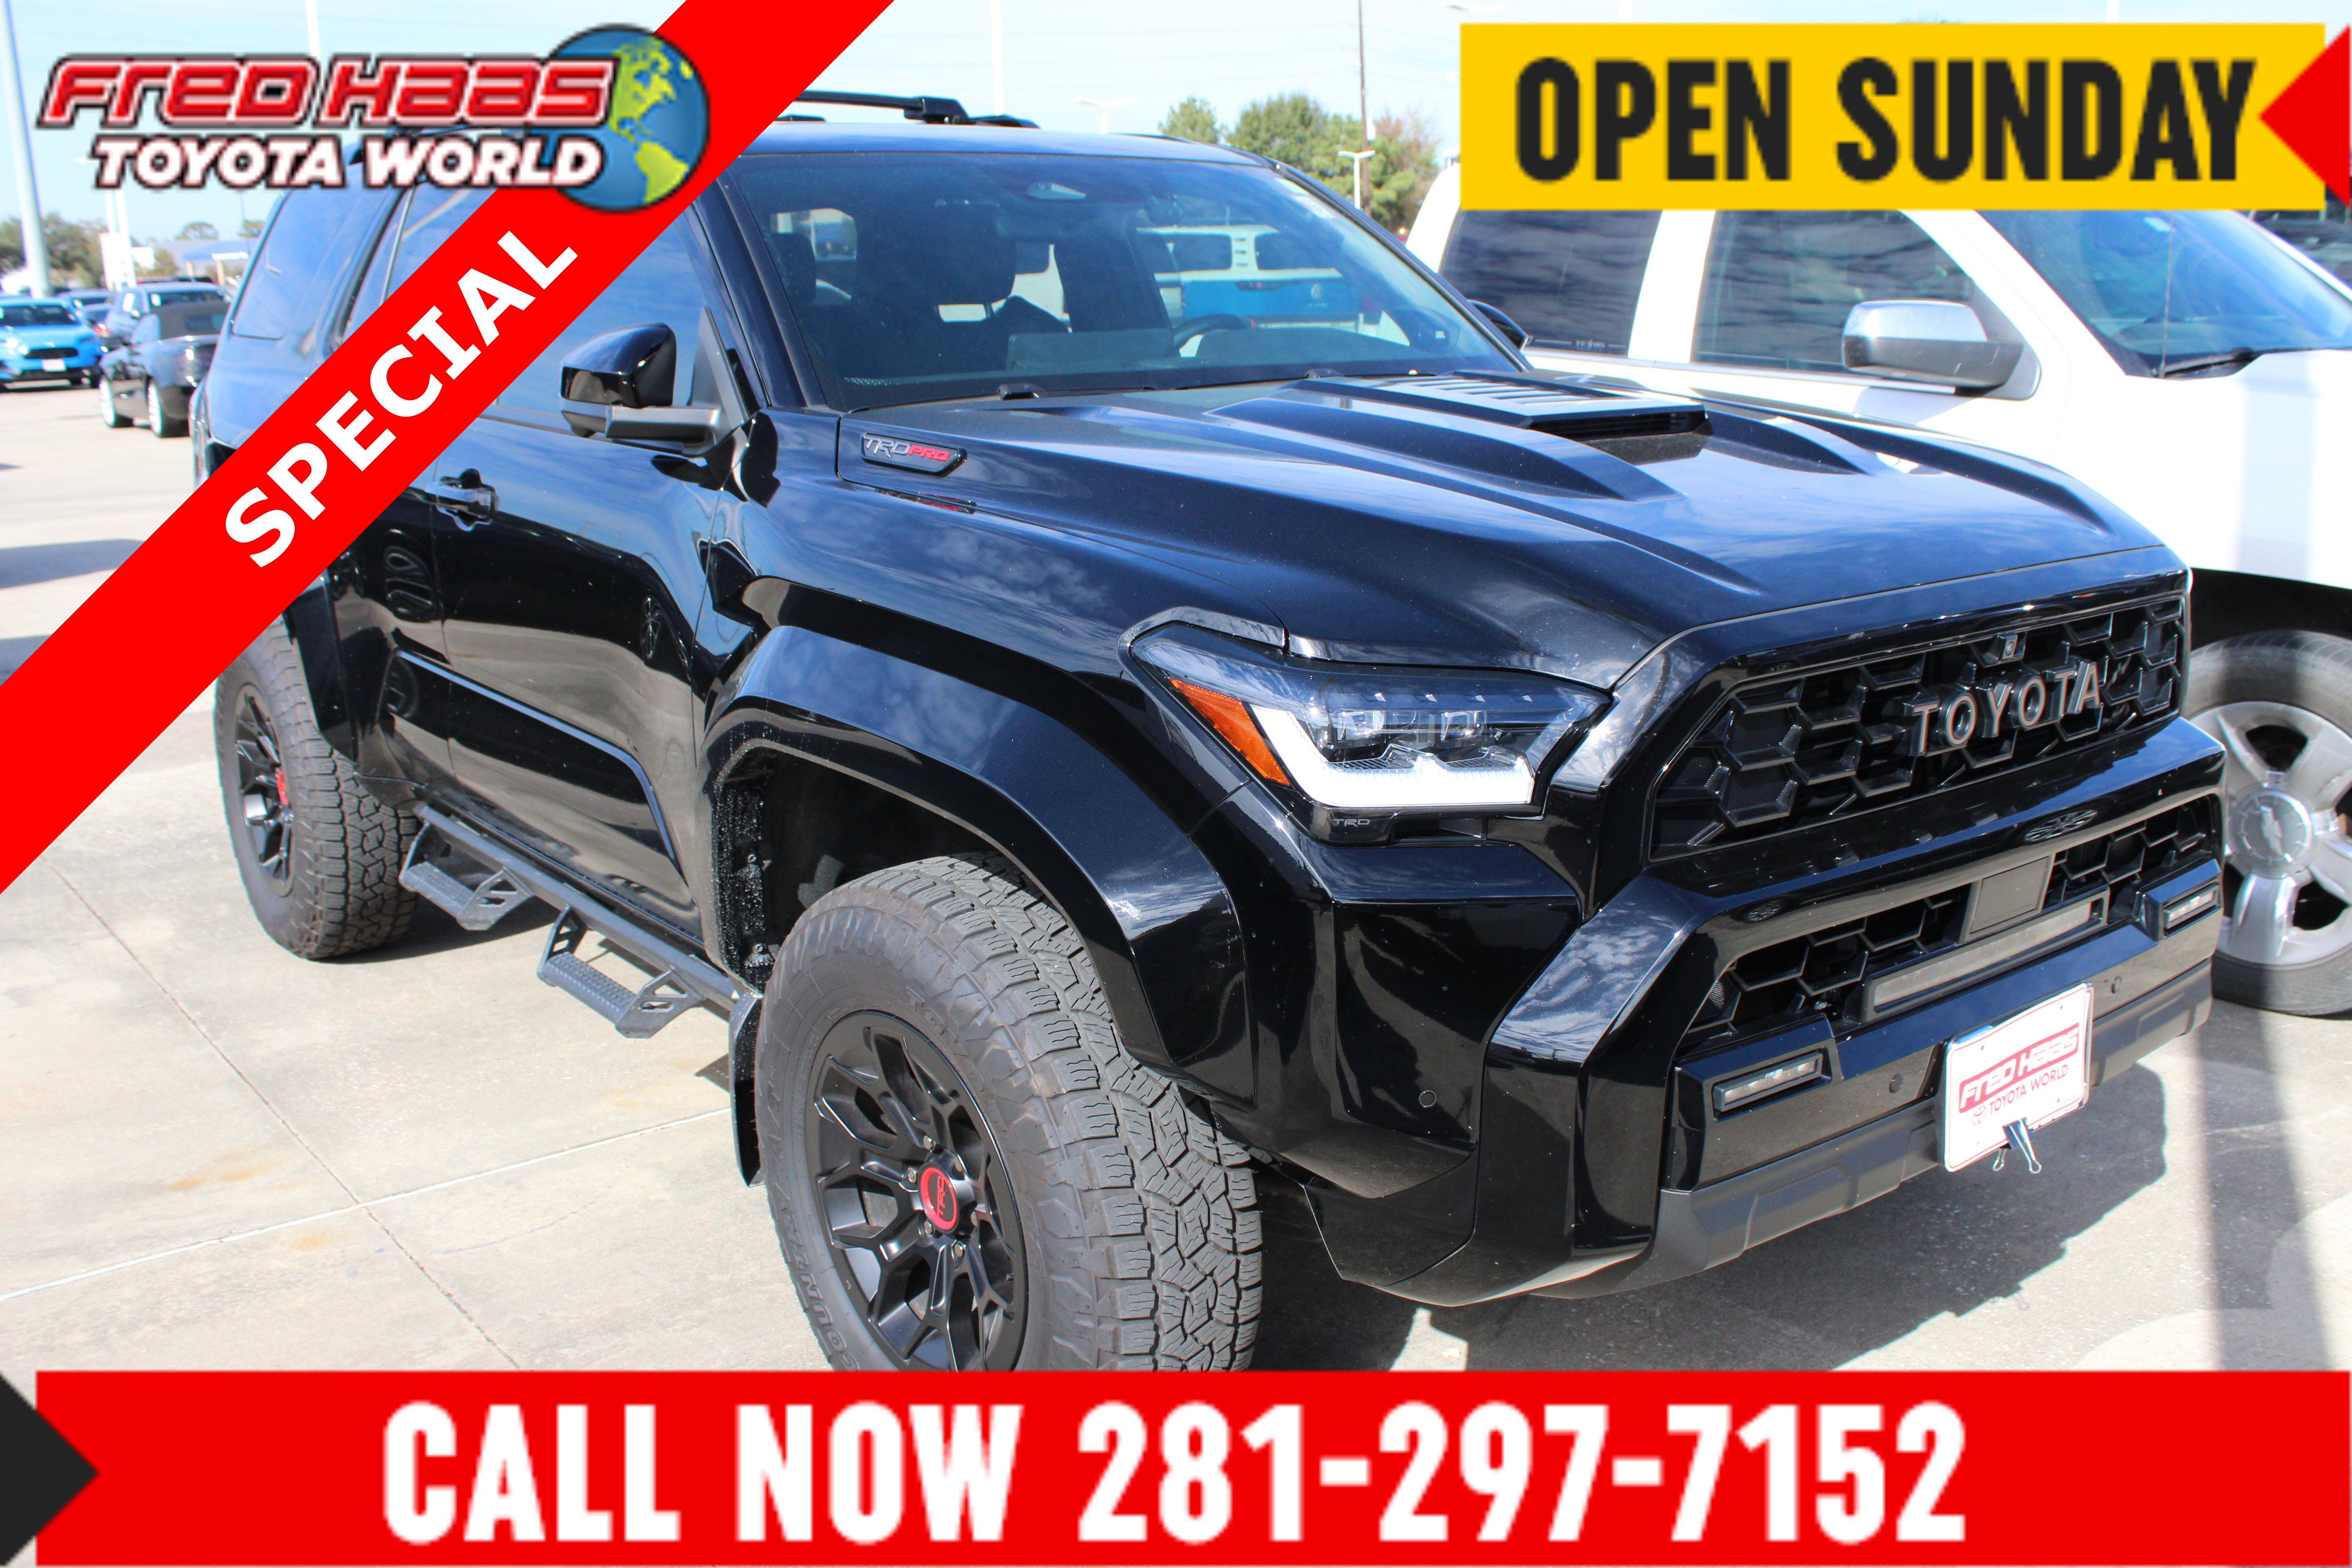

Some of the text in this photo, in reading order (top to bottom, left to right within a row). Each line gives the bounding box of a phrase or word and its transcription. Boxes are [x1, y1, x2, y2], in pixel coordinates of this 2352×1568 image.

[863, 436, 951, 461] TRD PRO
[1905, 659, 2101, 757] TOYOTA
[1332, 819, 1370, 827] TRD
[1990, 1064, 2069, 1115] TOYOTA WORLD
[936, 1175, 947, 1217] TRD
